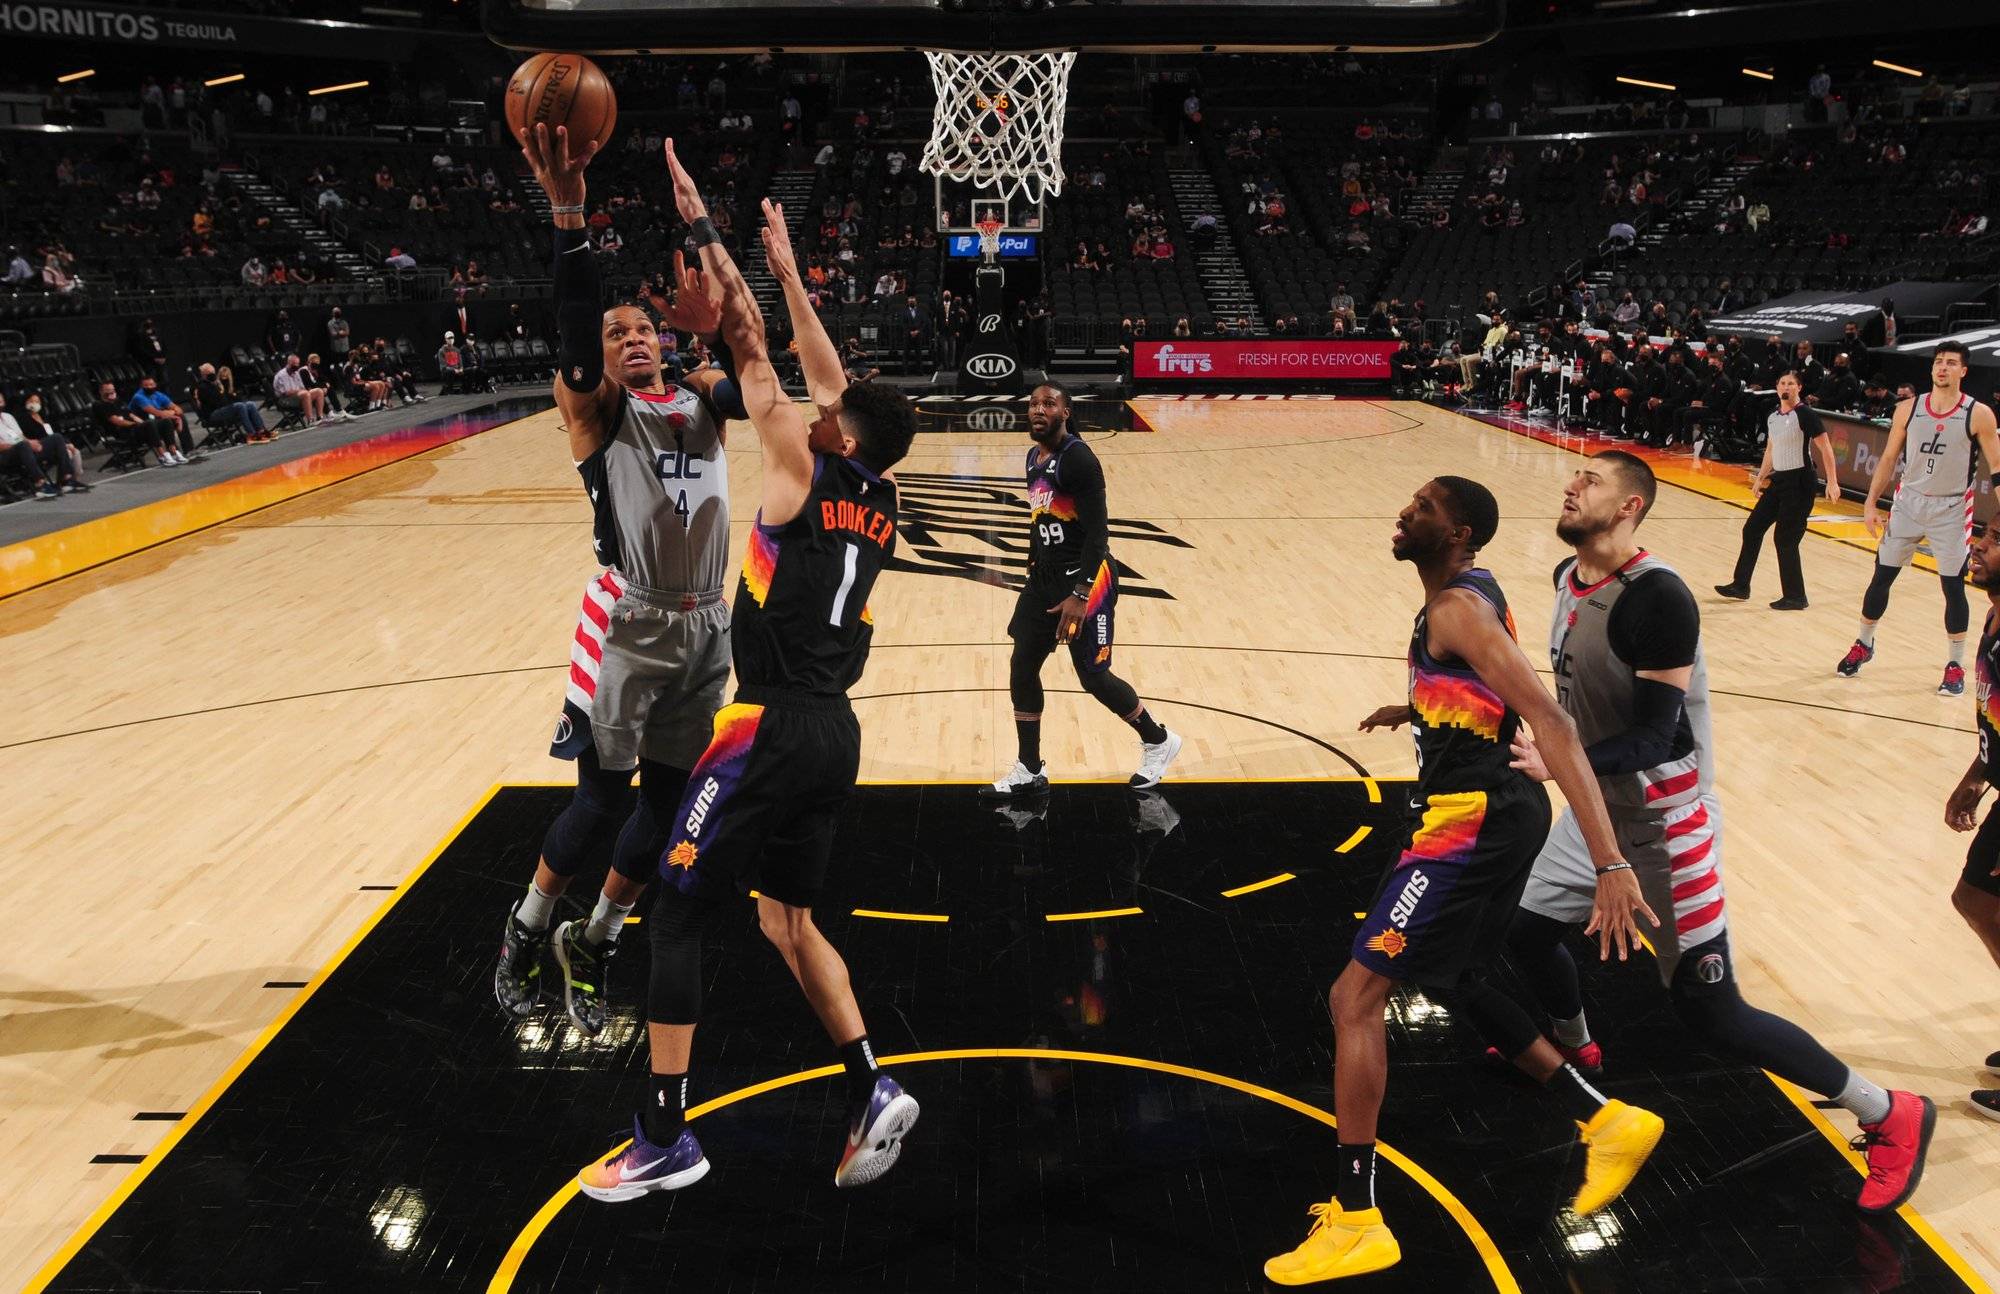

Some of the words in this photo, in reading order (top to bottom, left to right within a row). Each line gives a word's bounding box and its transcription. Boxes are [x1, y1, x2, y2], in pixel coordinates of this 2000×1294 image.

[0, 4, 158, 40] HORNITOS
[165, 22, 236, 41] TEQUILA
[975, 359, 1008, 373] KIA
[1153, 344, 1213, 374] fry's
[1238, 353, 1277, 366] FRESH
[1281, 353, 1308, 366] FOR
[1926, 458, 1935, 474] 9
[674, 489, 690, 528] 4
[821, 500, 893, 549] BOOKER
[1038, 522, 1065, 546] 99
[829, 542, 859, 627] 1
[1096, 614, 1107, 645] SUNS
[686, 776, 719, 838] SUNS
[1390, 869, 1430, 928] SUNS
